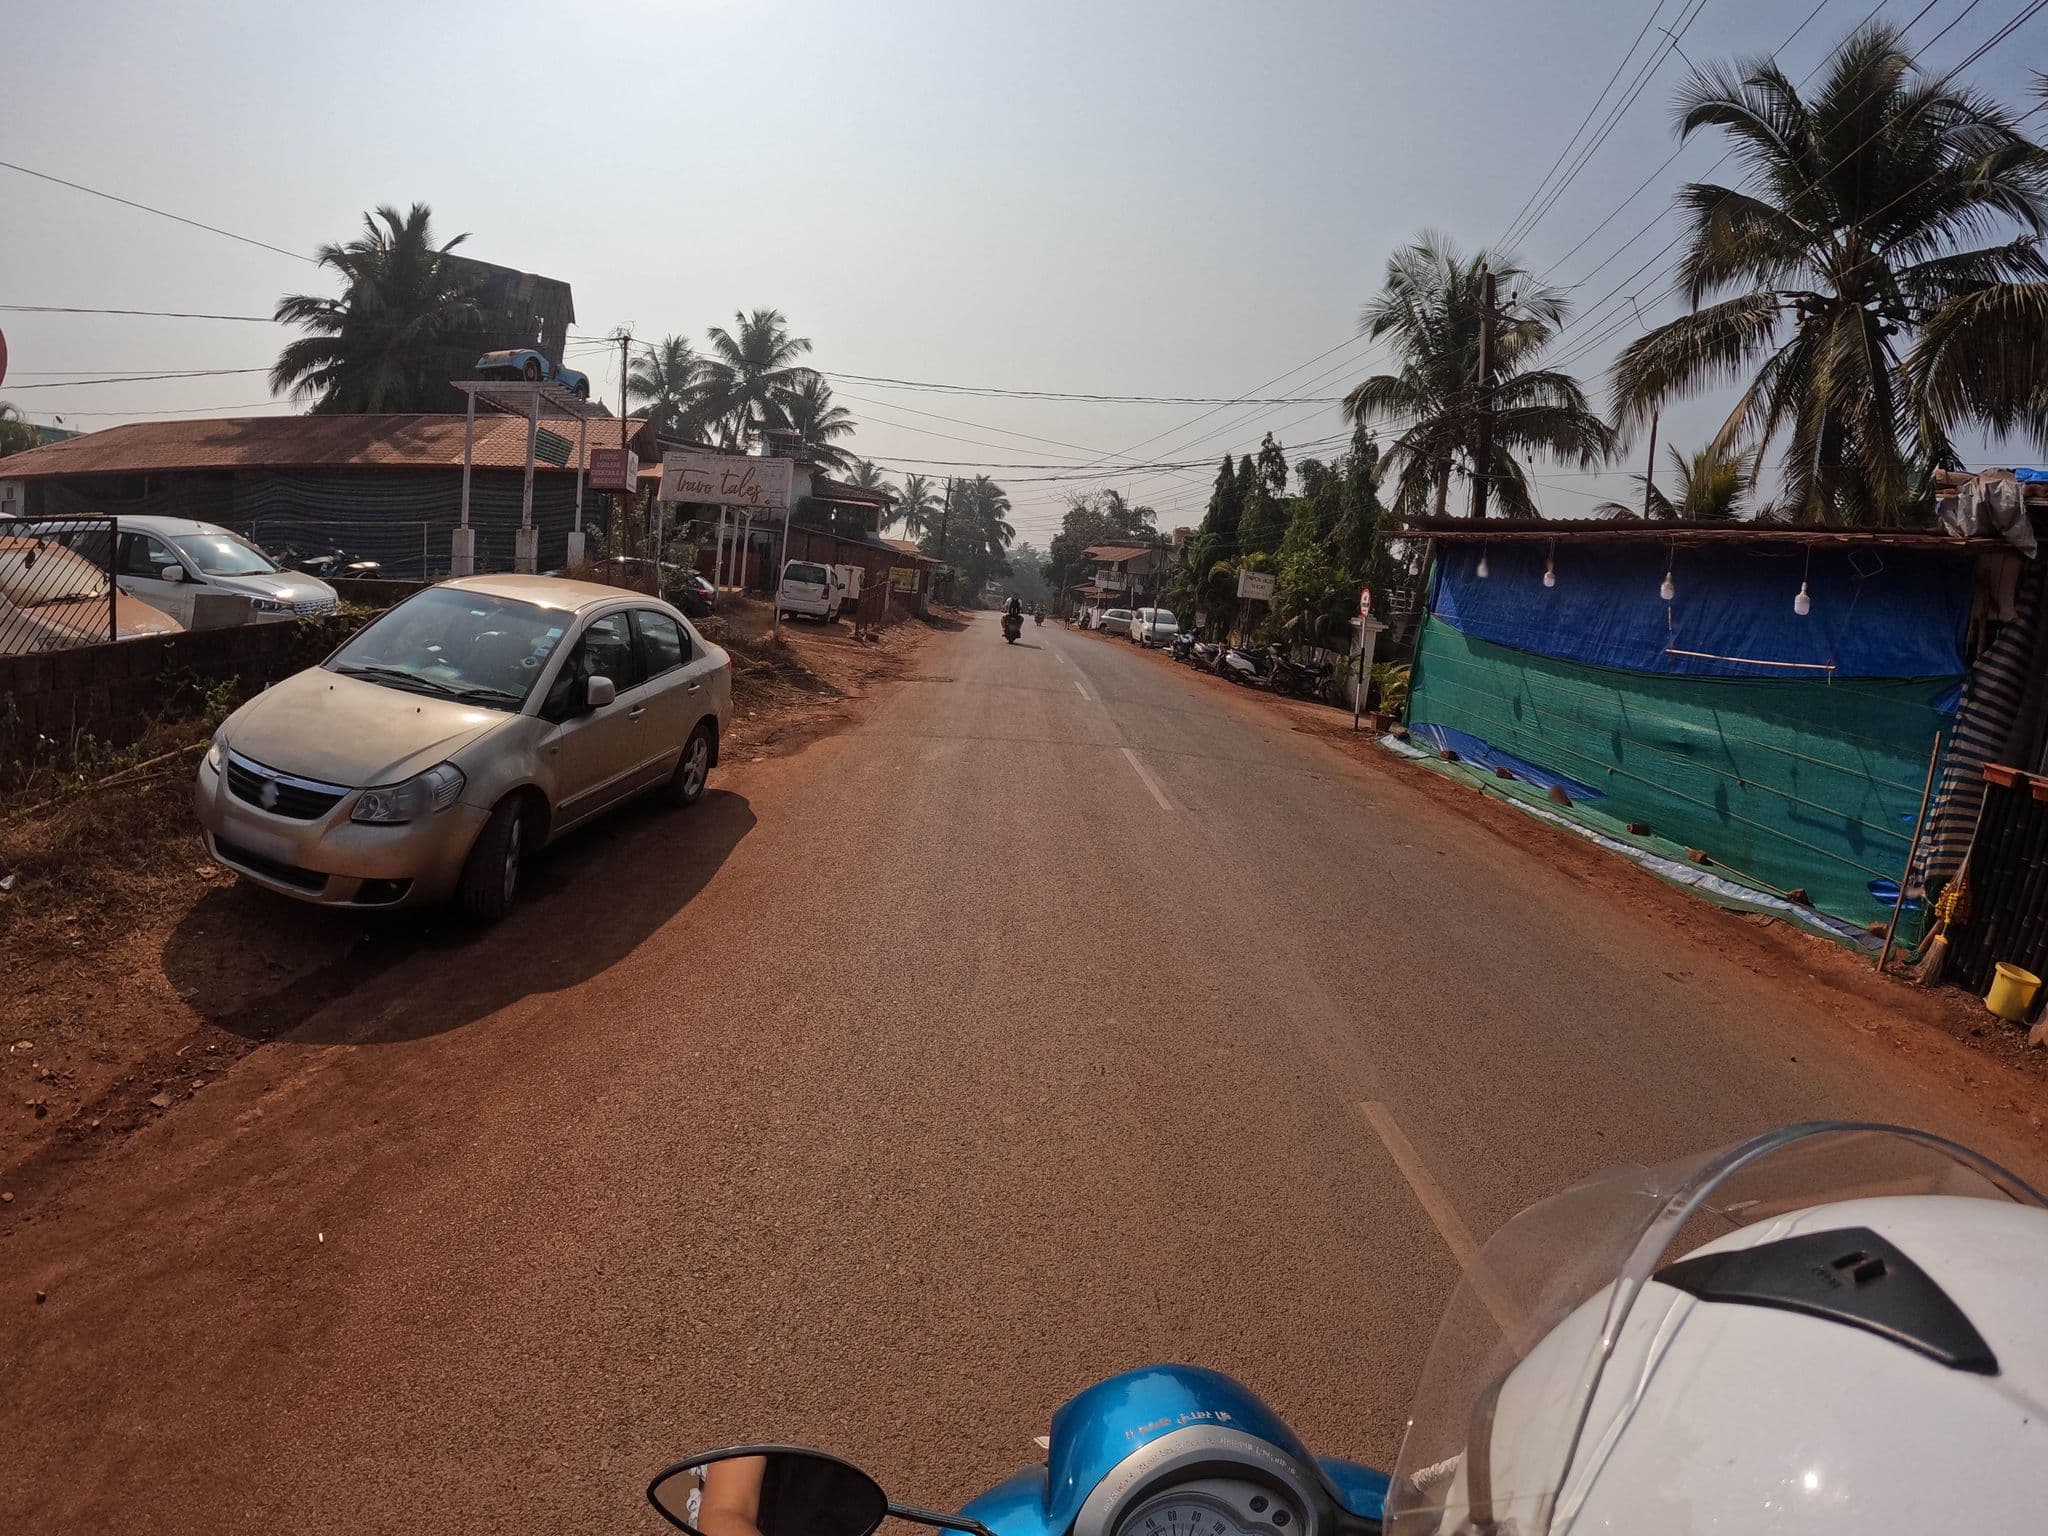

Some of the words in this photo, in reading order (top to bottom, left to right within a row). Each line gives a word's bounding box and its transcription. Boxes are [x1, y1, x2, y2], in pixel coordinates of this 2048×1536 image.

[720, 466, 762, 505] tales
[1168, 1510, 1178, 1522] 60
[1191, 1510, 1202, 1522] 80
[1212, 1521, 1226, 1534] 100
